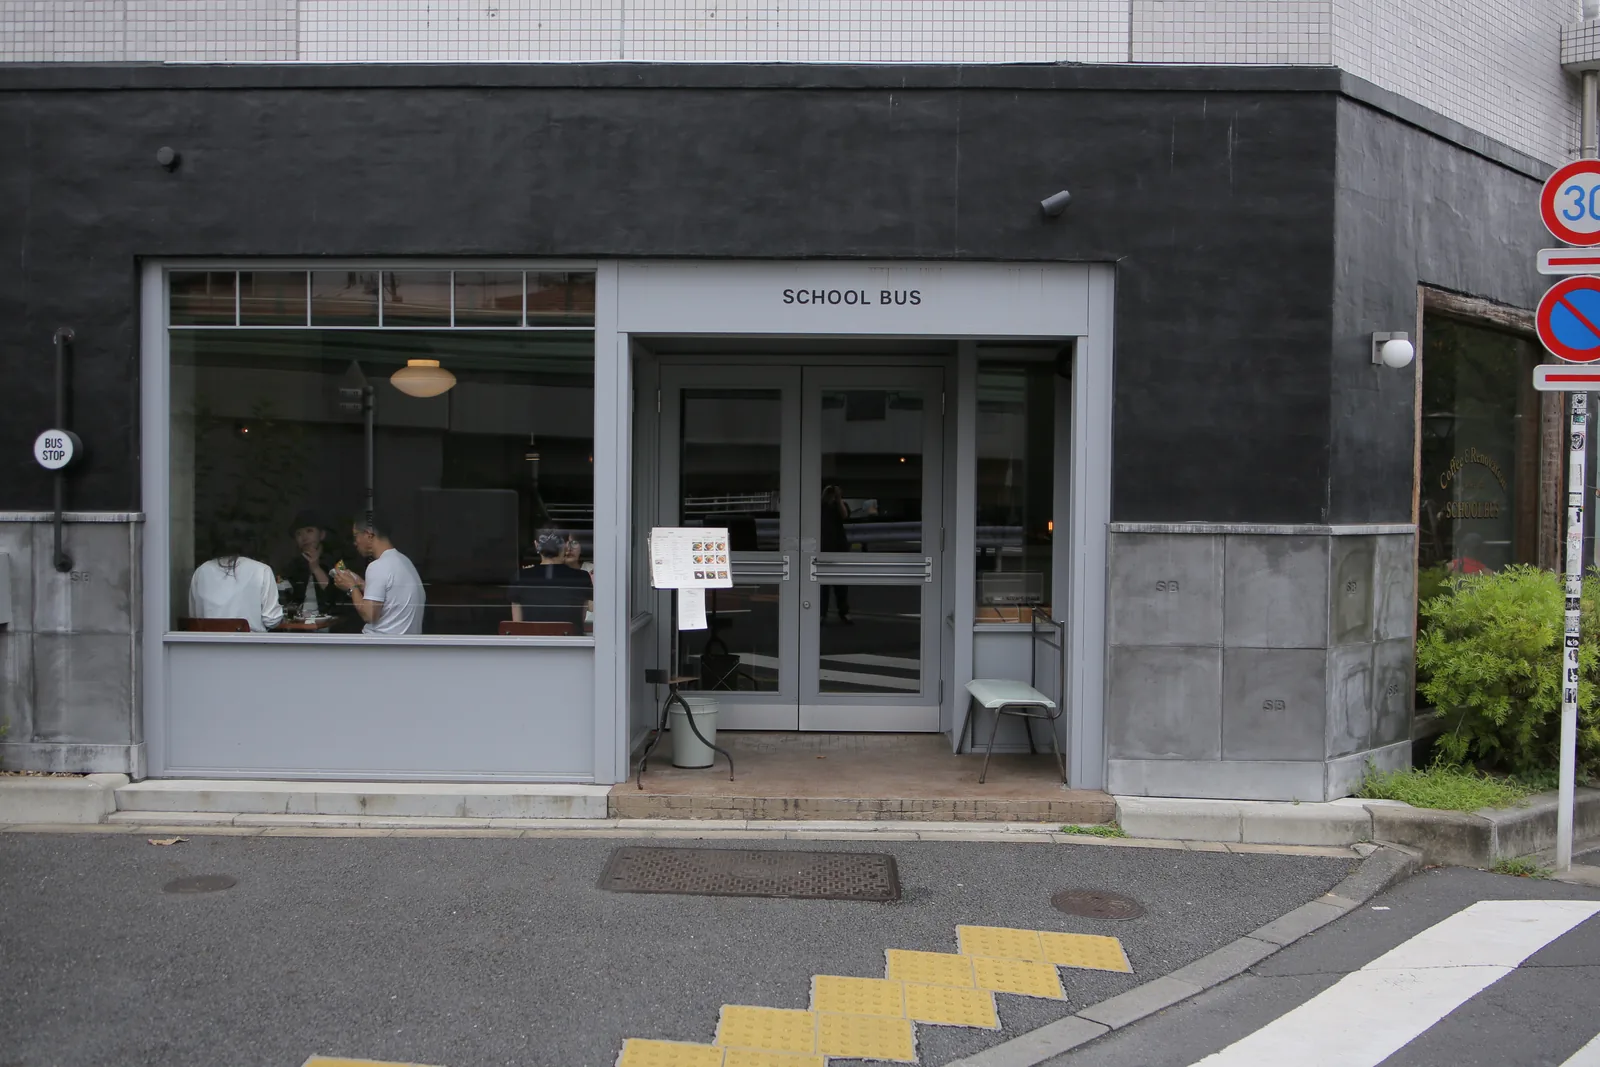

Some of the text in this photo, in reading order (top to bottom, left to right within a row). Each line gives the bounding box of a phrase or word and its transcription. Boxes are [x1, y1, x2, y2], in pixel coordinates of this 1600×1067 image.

[783, 289, 922, 305] SCHOOL BUS
[45, 438, 63, 449] BUS
[42, 450, 65, 461] STOP
[1440, 456, 1464, 489] Coffee
[1446, 501, 1499, 518] SCHOOL BUS
[1156, 580, 1179, 592] SB
[1262, 700, 1286, 711] SB
